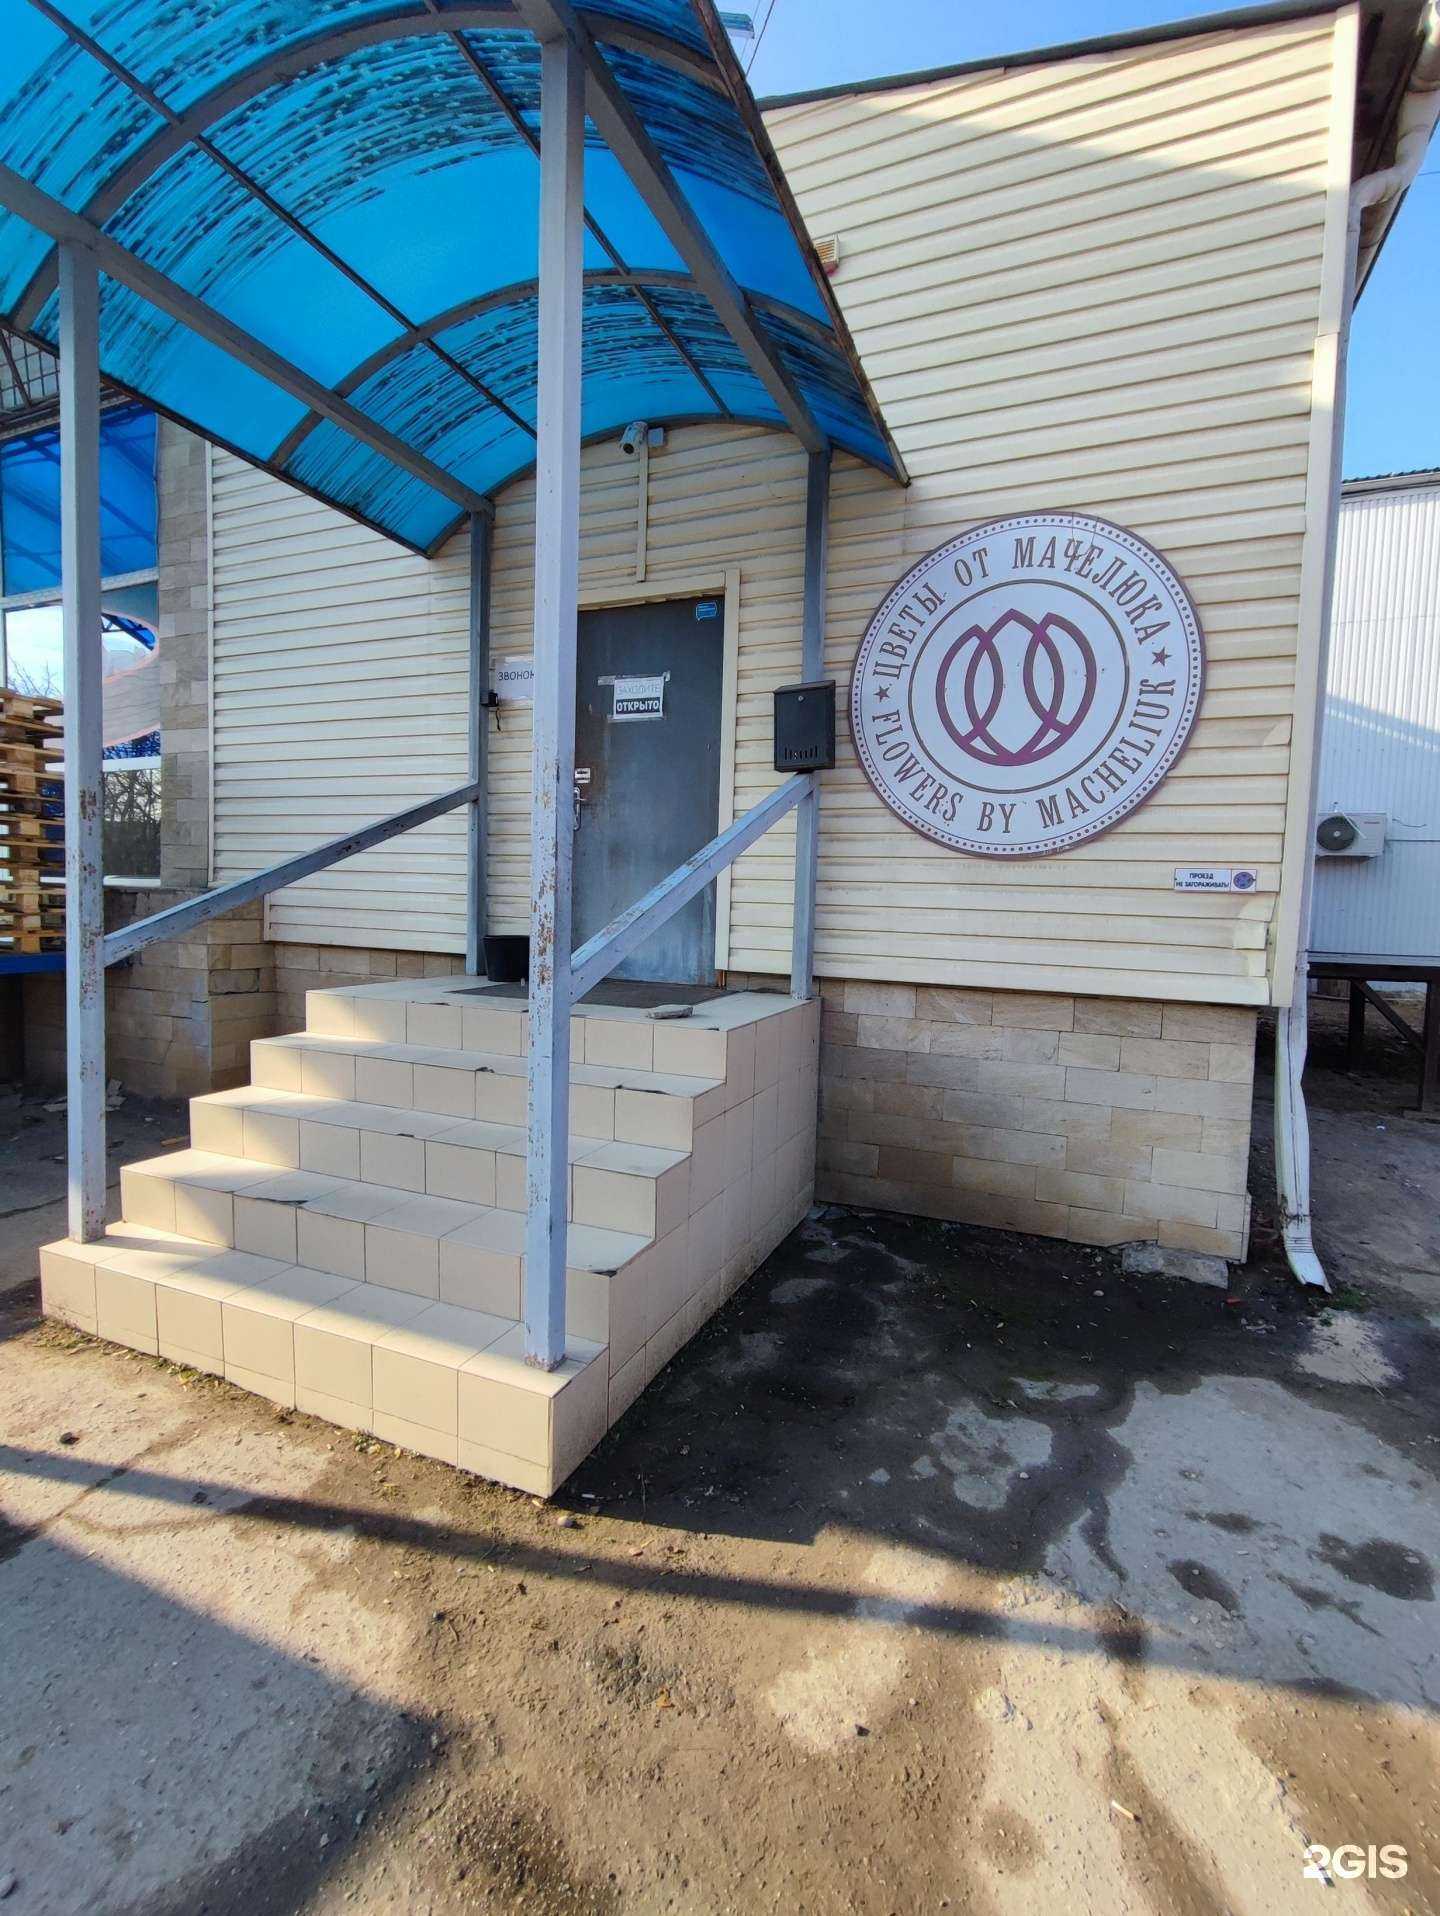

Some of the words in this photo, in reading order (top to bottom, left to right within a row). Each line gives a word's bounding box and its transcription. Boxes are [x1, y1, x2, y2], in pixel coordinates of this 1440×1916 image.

[872, 582, 946, 680] ЦВЕТЫ
[953, 547, 990, 588] ОТ
[1011, 535, 1171, 645] МАЧЕЛЮКА
[616, 701, 660, 712] ОТКРЫТО
[872, 709, 964, 823] FLOWERS
[976, 801, 1017, 834] BY
[1036, 678, 1177, 829] MACHELIUK
[1189, 872, 1214, 880] ПРОЕЗД
